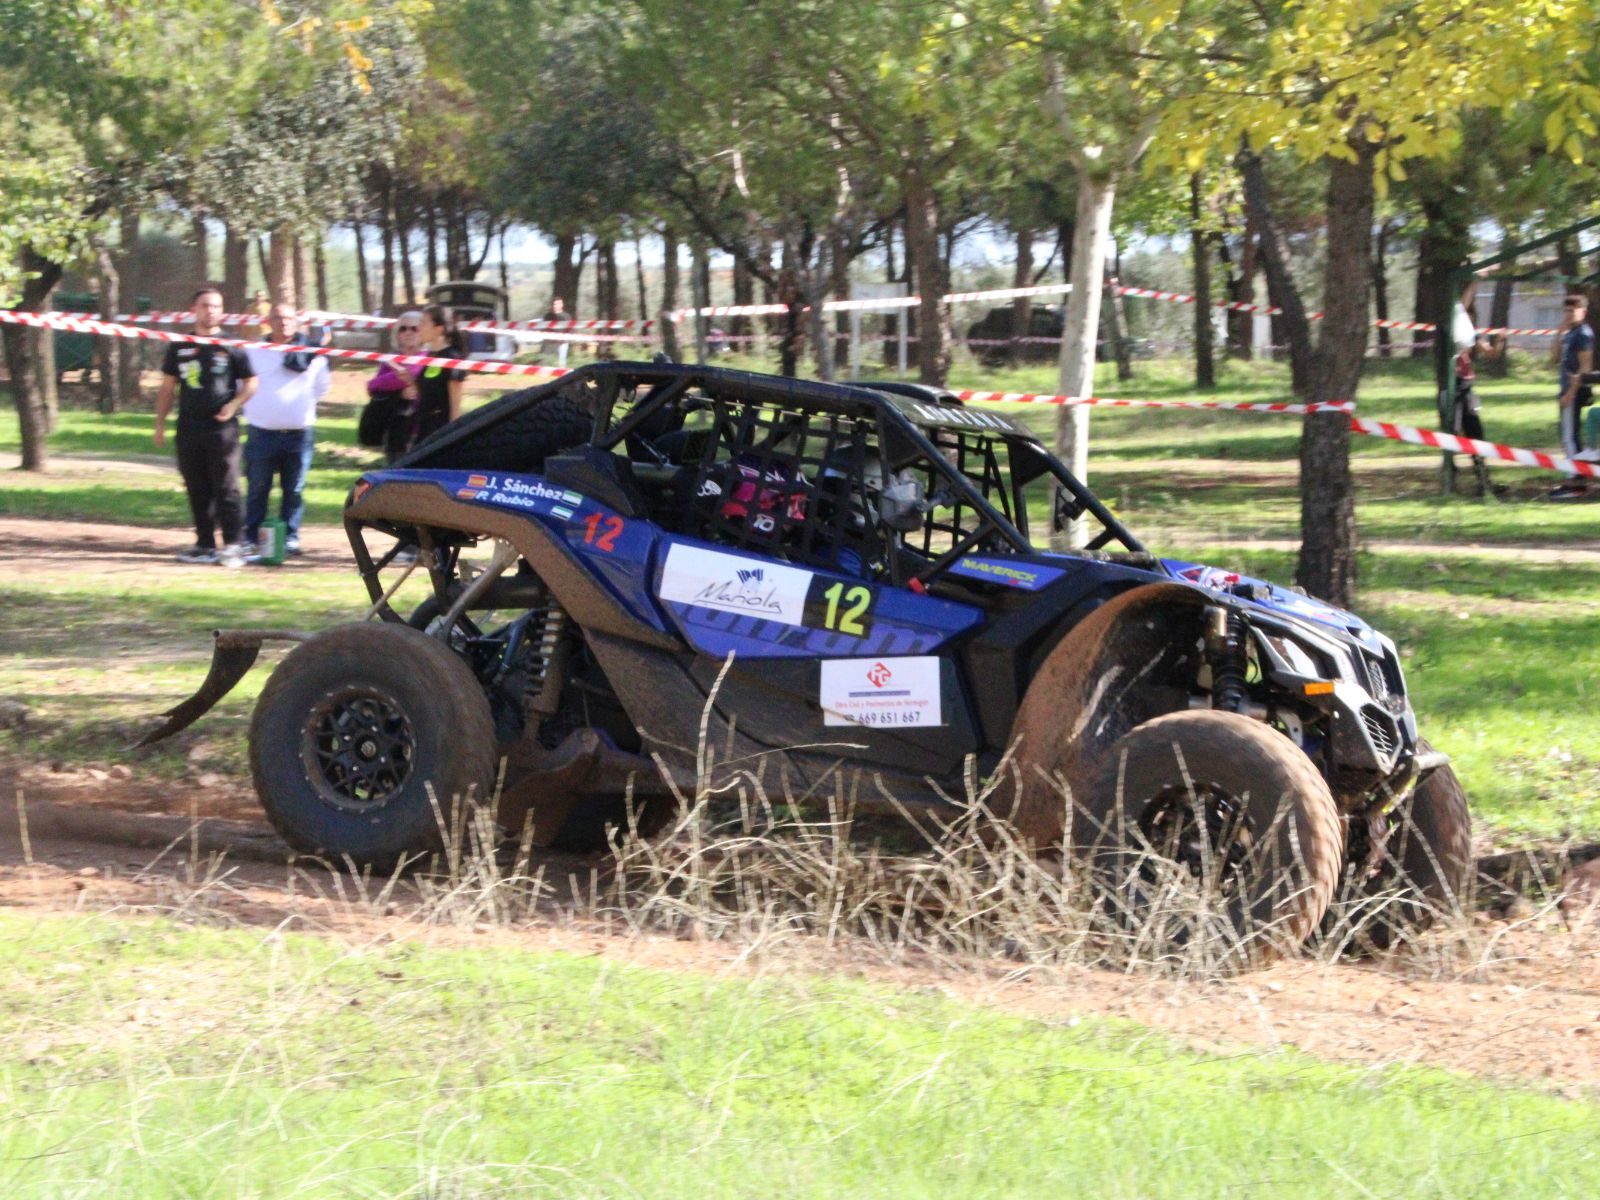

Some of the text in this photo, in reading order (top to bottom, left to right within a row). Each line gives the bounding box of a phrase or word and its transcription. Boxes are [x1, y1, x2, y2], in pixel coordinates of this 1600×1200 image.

[486, 476, 563, 500] J. Sánchez
[492, 493, 535, 507] Rubio
[584, 512, 624, 552] 12
[962, 559, 1037, 582] MAVERICK
[694, 580, 782, 613] Mariola
[825, 582, 871, 635] 12
[859, 711, 920, 725] 669 651 667
